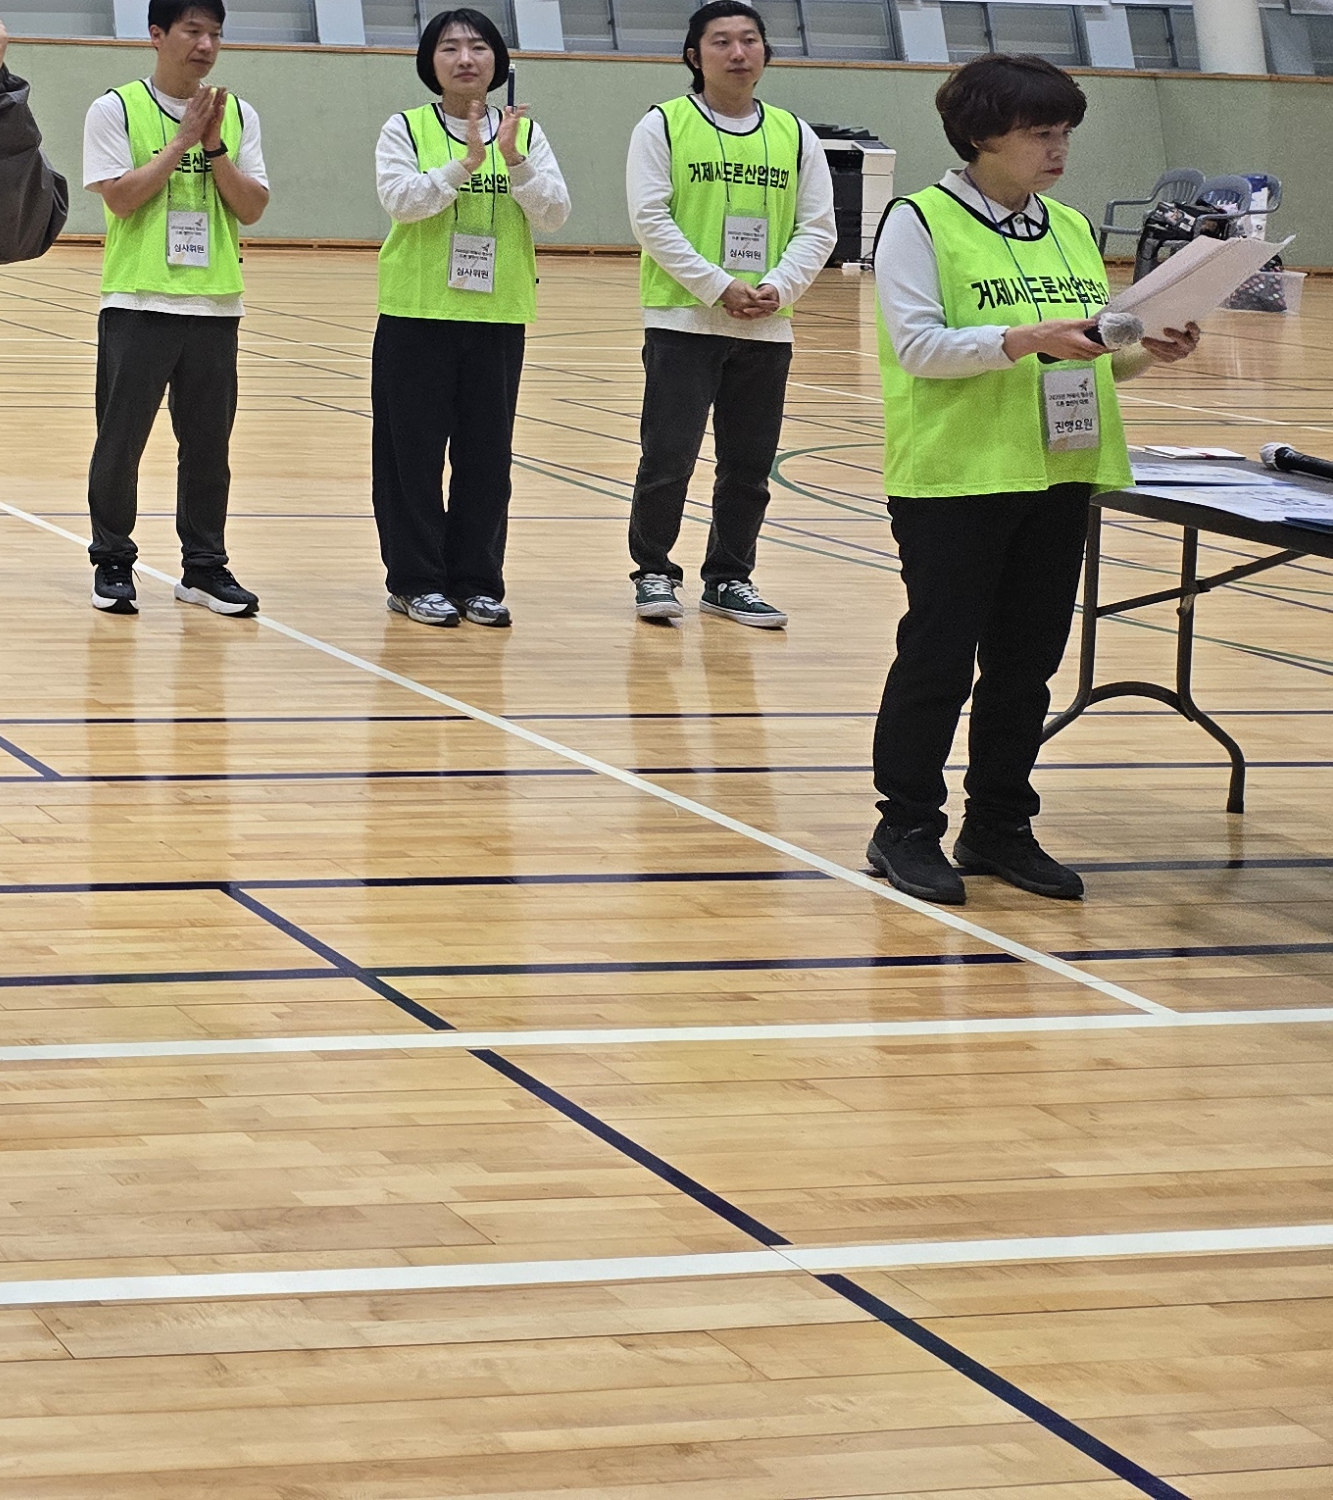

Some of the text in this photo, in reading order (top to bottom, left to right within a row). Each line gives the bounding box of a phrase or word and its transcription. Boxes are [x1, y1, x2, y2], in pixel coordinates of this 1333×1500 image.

[687, 160, 790, 190] 거제시드론산업협회
[173, 243, 205, 254] 심사위원
[729, 248, 762, 261] 심사위원
[456, 266, 489, 280] 심사위원
[1054, 418, 1094, 434] 진행요원
